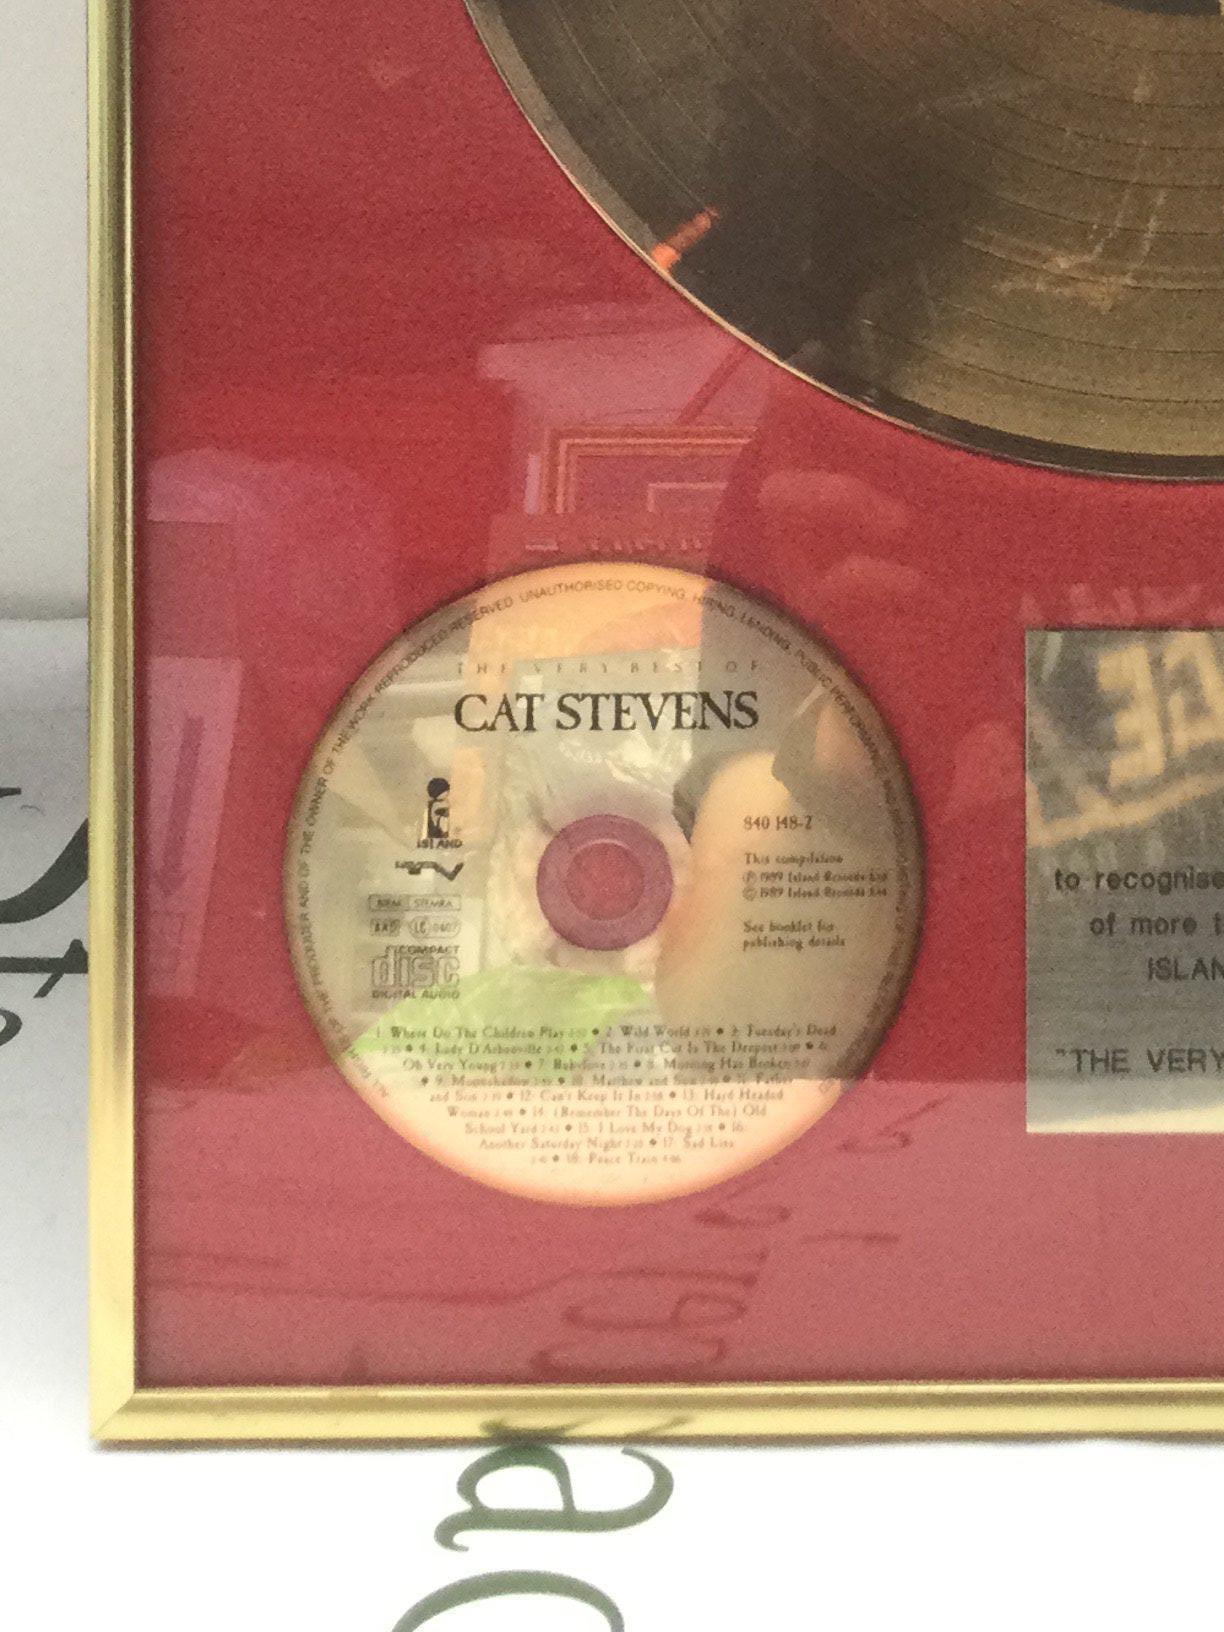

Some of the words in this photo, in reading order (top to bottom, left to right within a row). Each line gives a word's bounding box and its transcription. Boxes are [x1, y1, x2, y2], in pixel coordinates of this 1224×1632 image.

[454, 692, 544, 732] CAT
[556, 690, 759, 731] STEVENS
[743, 815, 770, 830] 840
[417, 838, 463, 849] ISLAND
[1055, 870, 1081, 890] to
[1090, 912, 1115, 936] of
[1131, 916, 1196, 936] more
